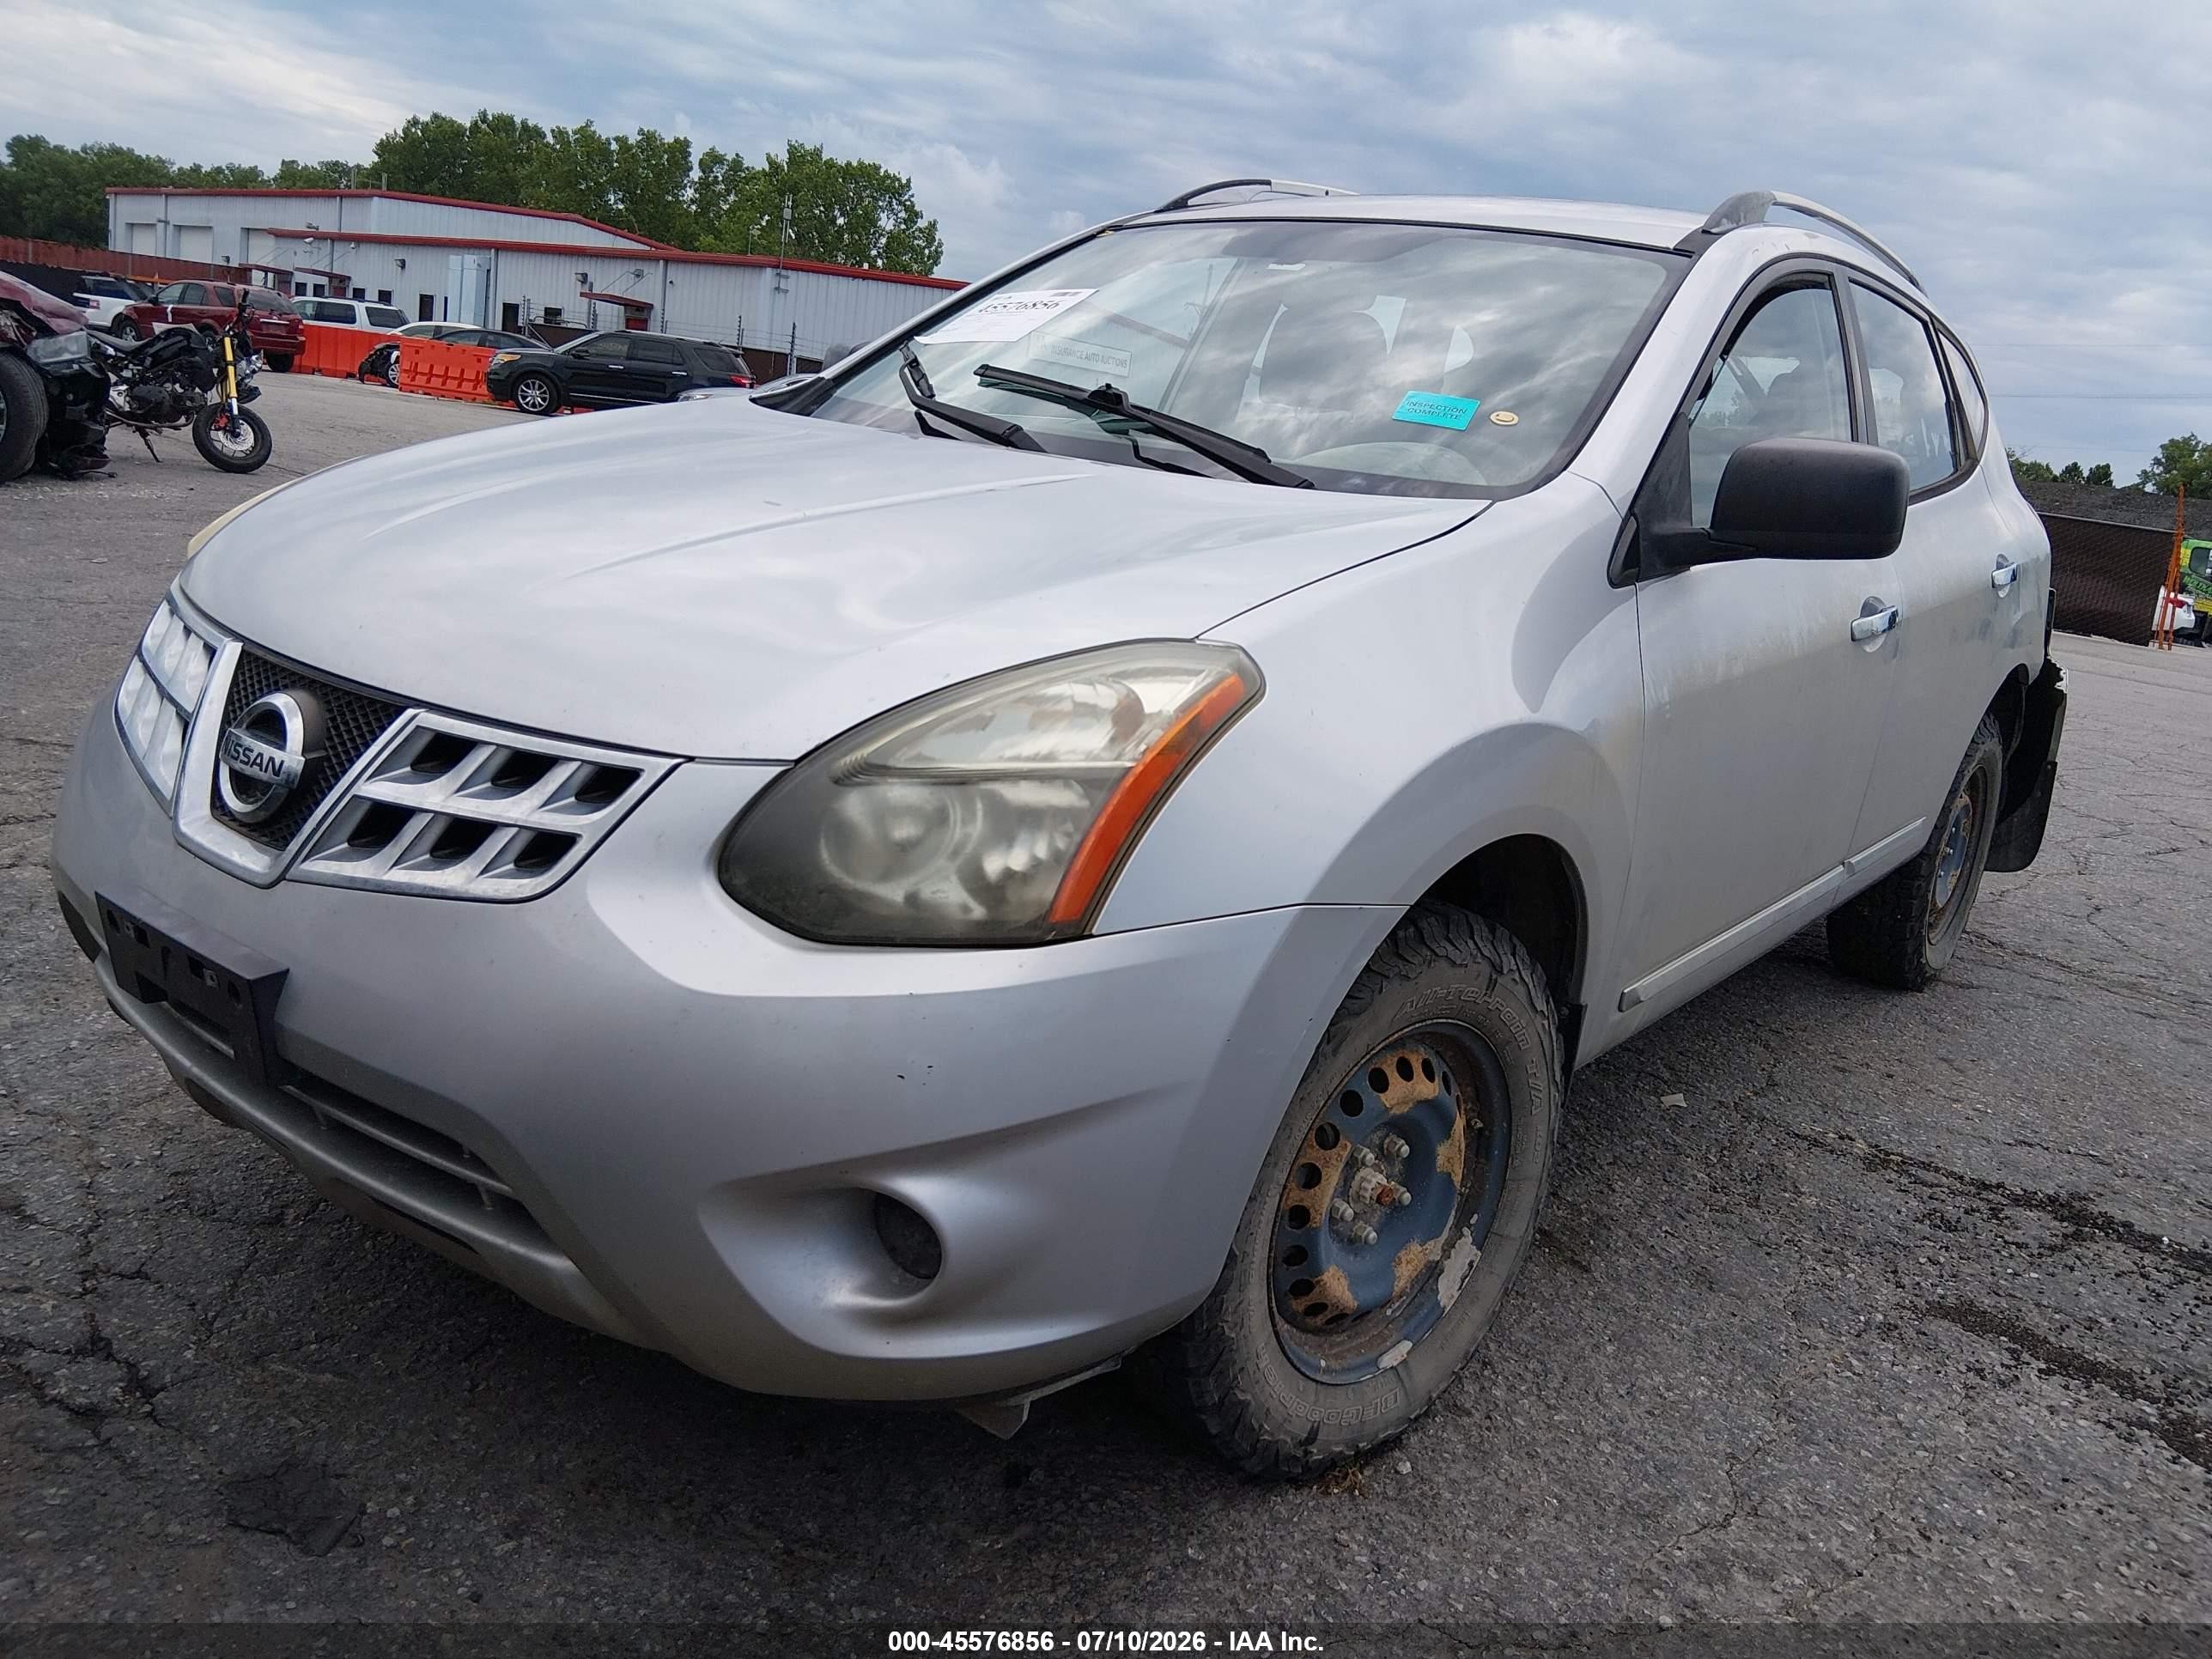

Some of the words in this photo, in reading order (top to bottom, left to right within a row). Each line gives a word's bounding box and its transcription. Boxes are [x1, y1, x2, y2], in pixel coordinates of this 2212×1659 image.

[1051, 344, 1085, 360] INSURANCE
[1085, 351, 1100, 363] AUTO
[1100, 354, 1128, 369] AUCTIONS
[1407, 400, 1467, 414] INSPECTION
[1407, 406, 1462, 421] COMPLETE
[223, 733, 285, 778] NISSAN
